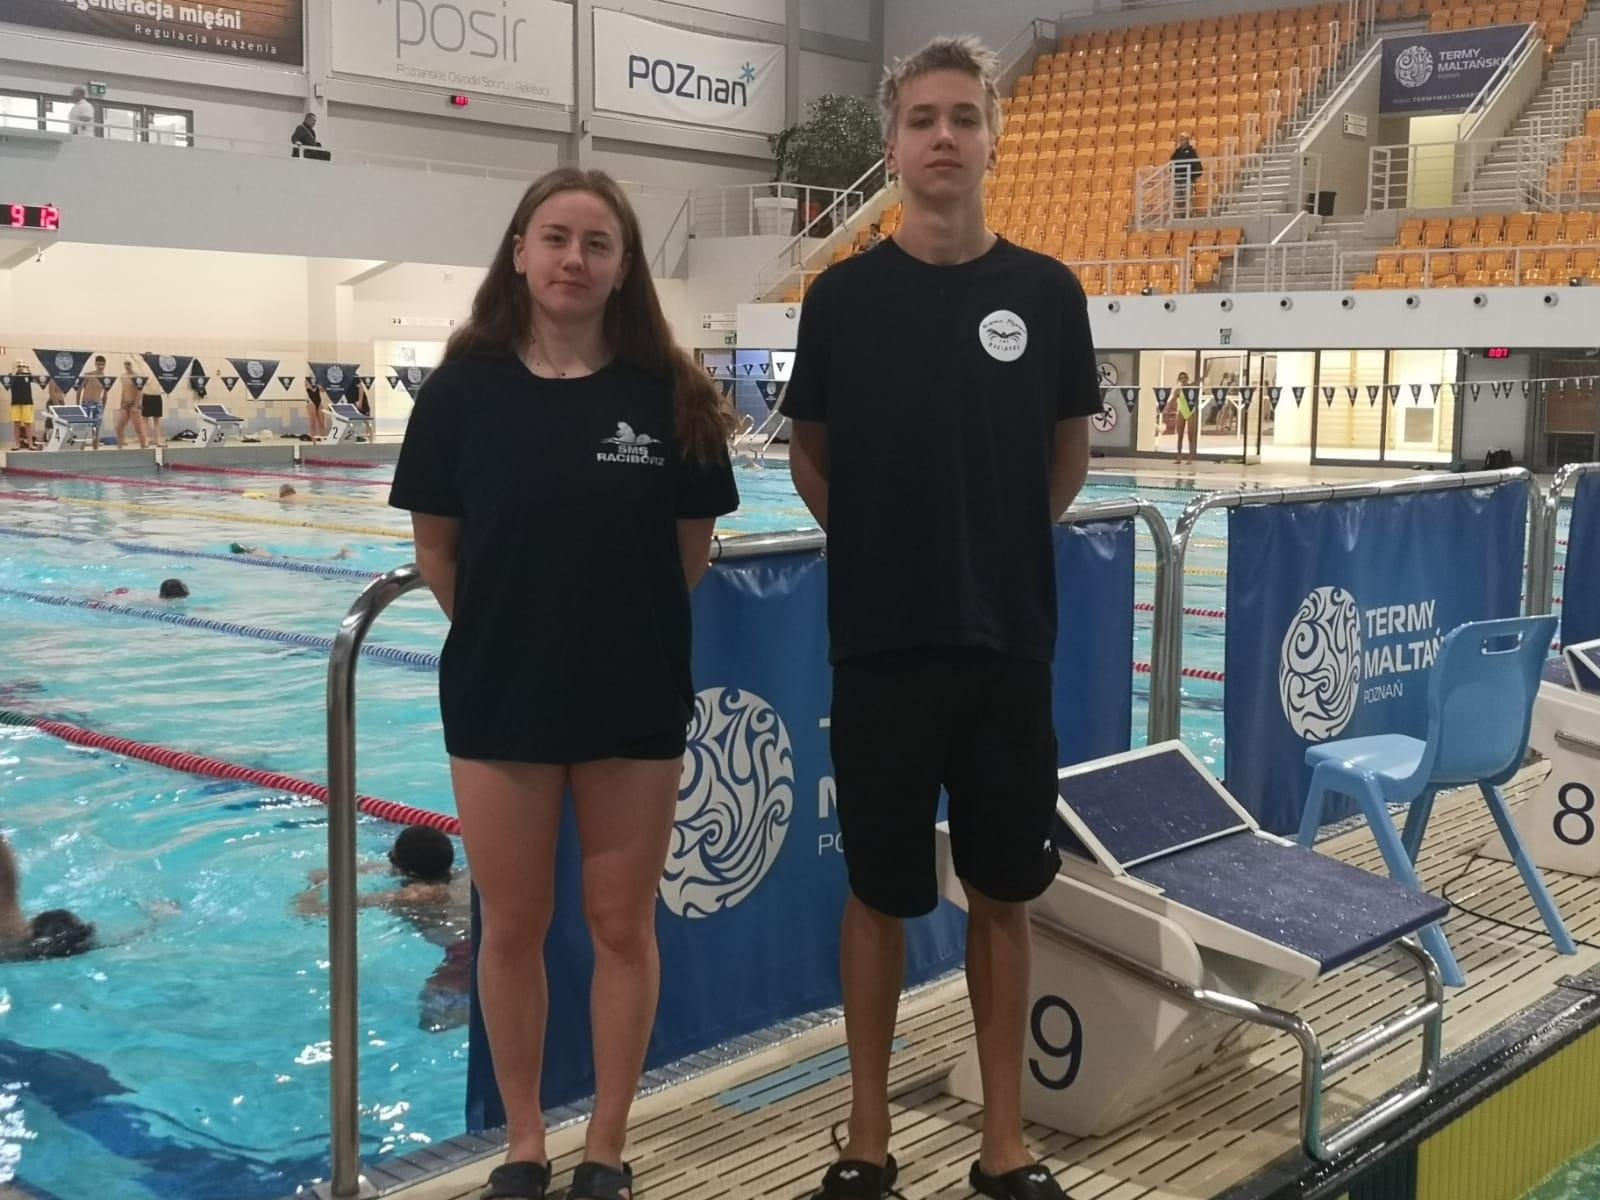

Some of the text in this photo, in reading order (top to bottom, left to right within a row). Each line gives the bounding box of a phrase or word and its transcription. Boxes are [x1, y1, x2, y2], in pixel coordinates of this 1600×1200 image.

[62, 0, 241, 30] generacja mięśni
[135, 24, 277, 54] Regulacja krążenia
[396, 0, 527, 63] posir
[1438, 48, 1481, 61] TERMY
[618, 445, 648, 456] SMS
[1365, 599, 1435, 639] TERMY
[1363, 679, 1404, 704] POZNAŃ
[1553, 782, 1595, 845] 8
[1028, 994, 1083, 1090] 9
